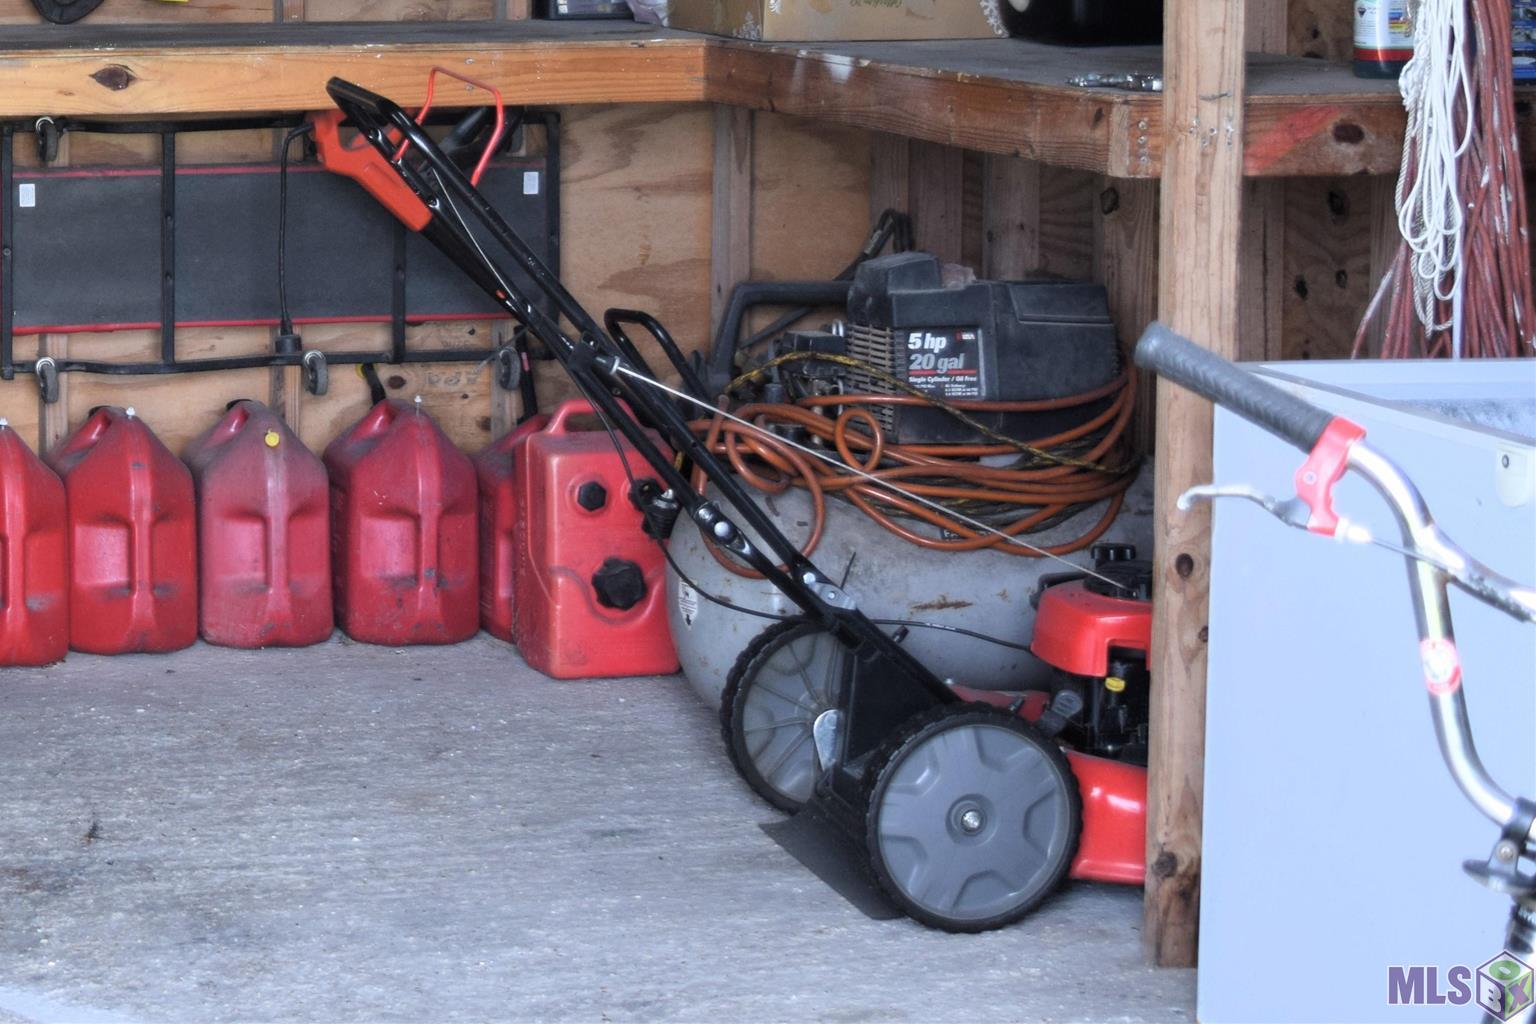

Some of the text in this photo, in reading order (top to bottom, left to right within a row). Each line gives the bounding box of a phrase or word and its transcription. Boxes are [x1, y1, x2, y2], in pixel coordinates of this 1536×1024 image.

[907, 332, 947, 353] 5 hp
[909, 352, 965, 374] 20 gal
